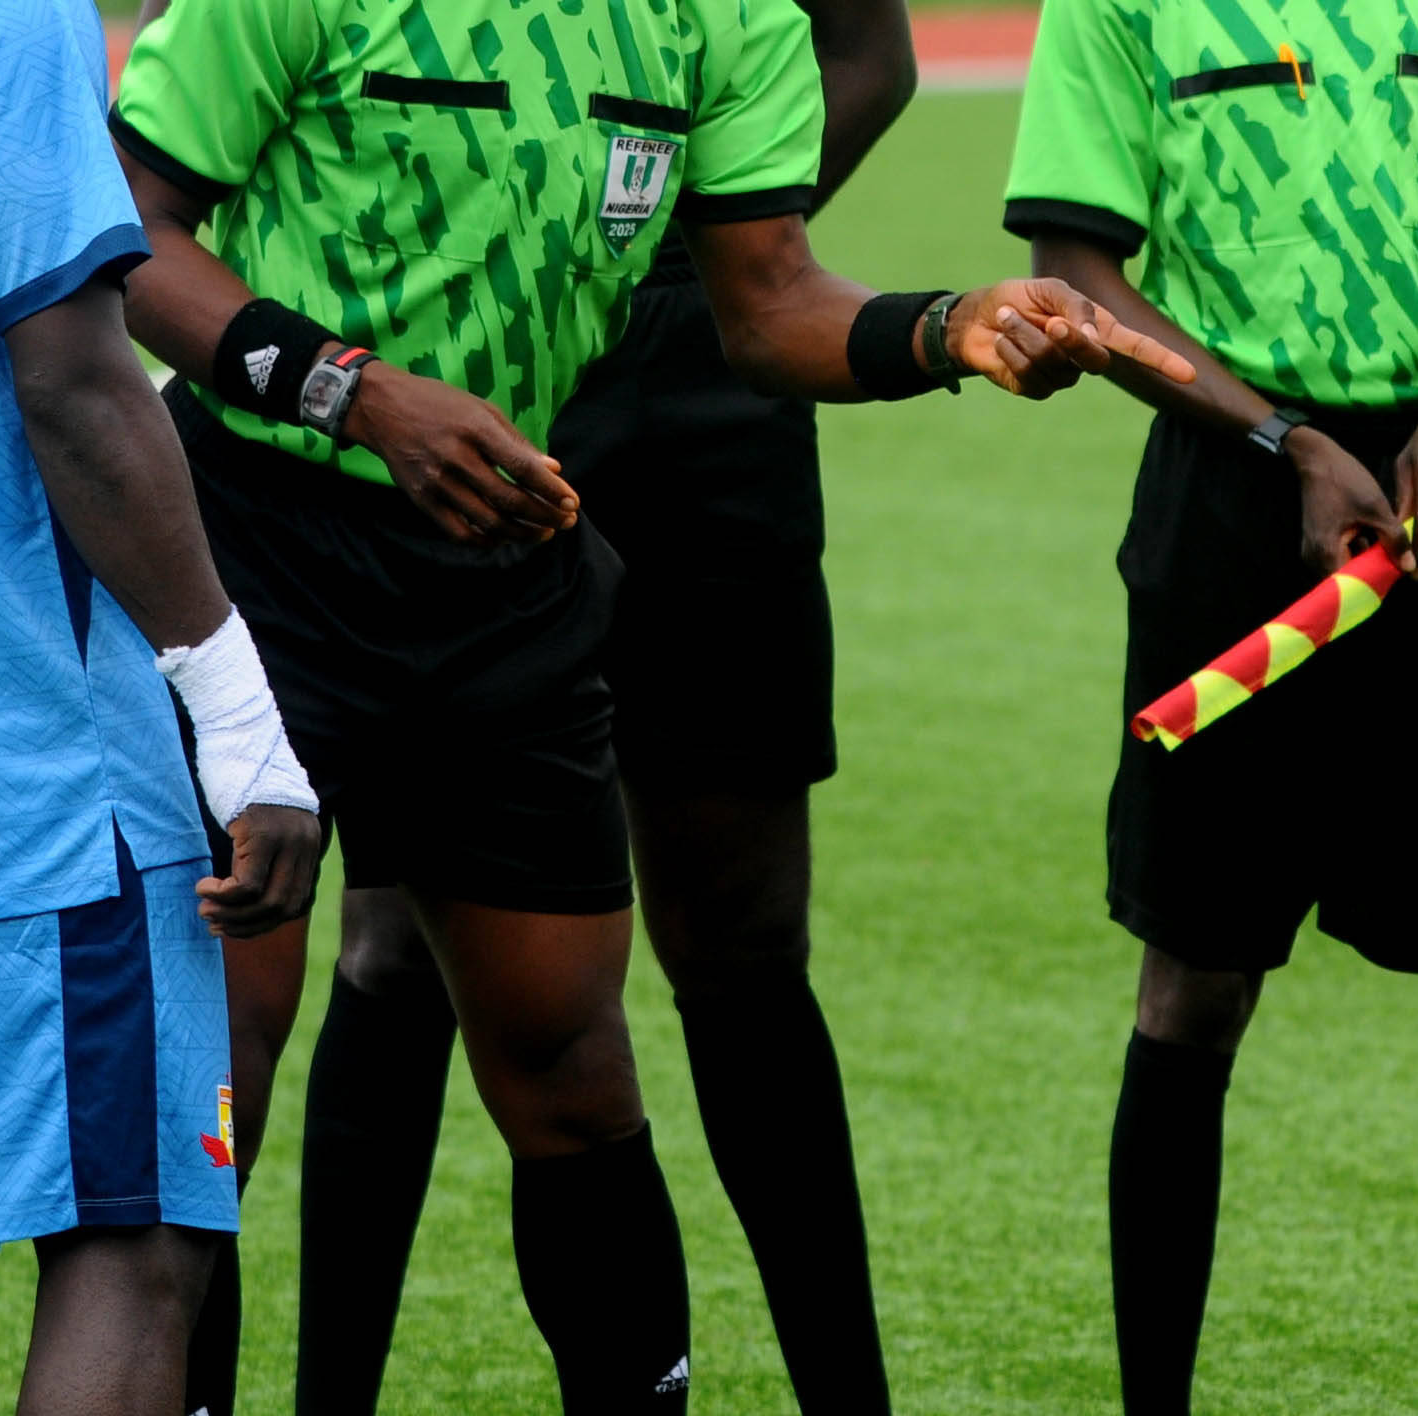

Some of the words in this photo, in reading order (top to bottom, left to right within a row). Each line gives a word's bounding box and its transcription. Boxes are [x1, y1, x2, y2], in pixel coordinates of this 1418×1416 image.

[616, 139, 674, 155] REFEREE
[606, 202, 651, 215] NIGERIA
[608, 223, 637, 237] 2025
[256, 344, 280, 396] adidas
